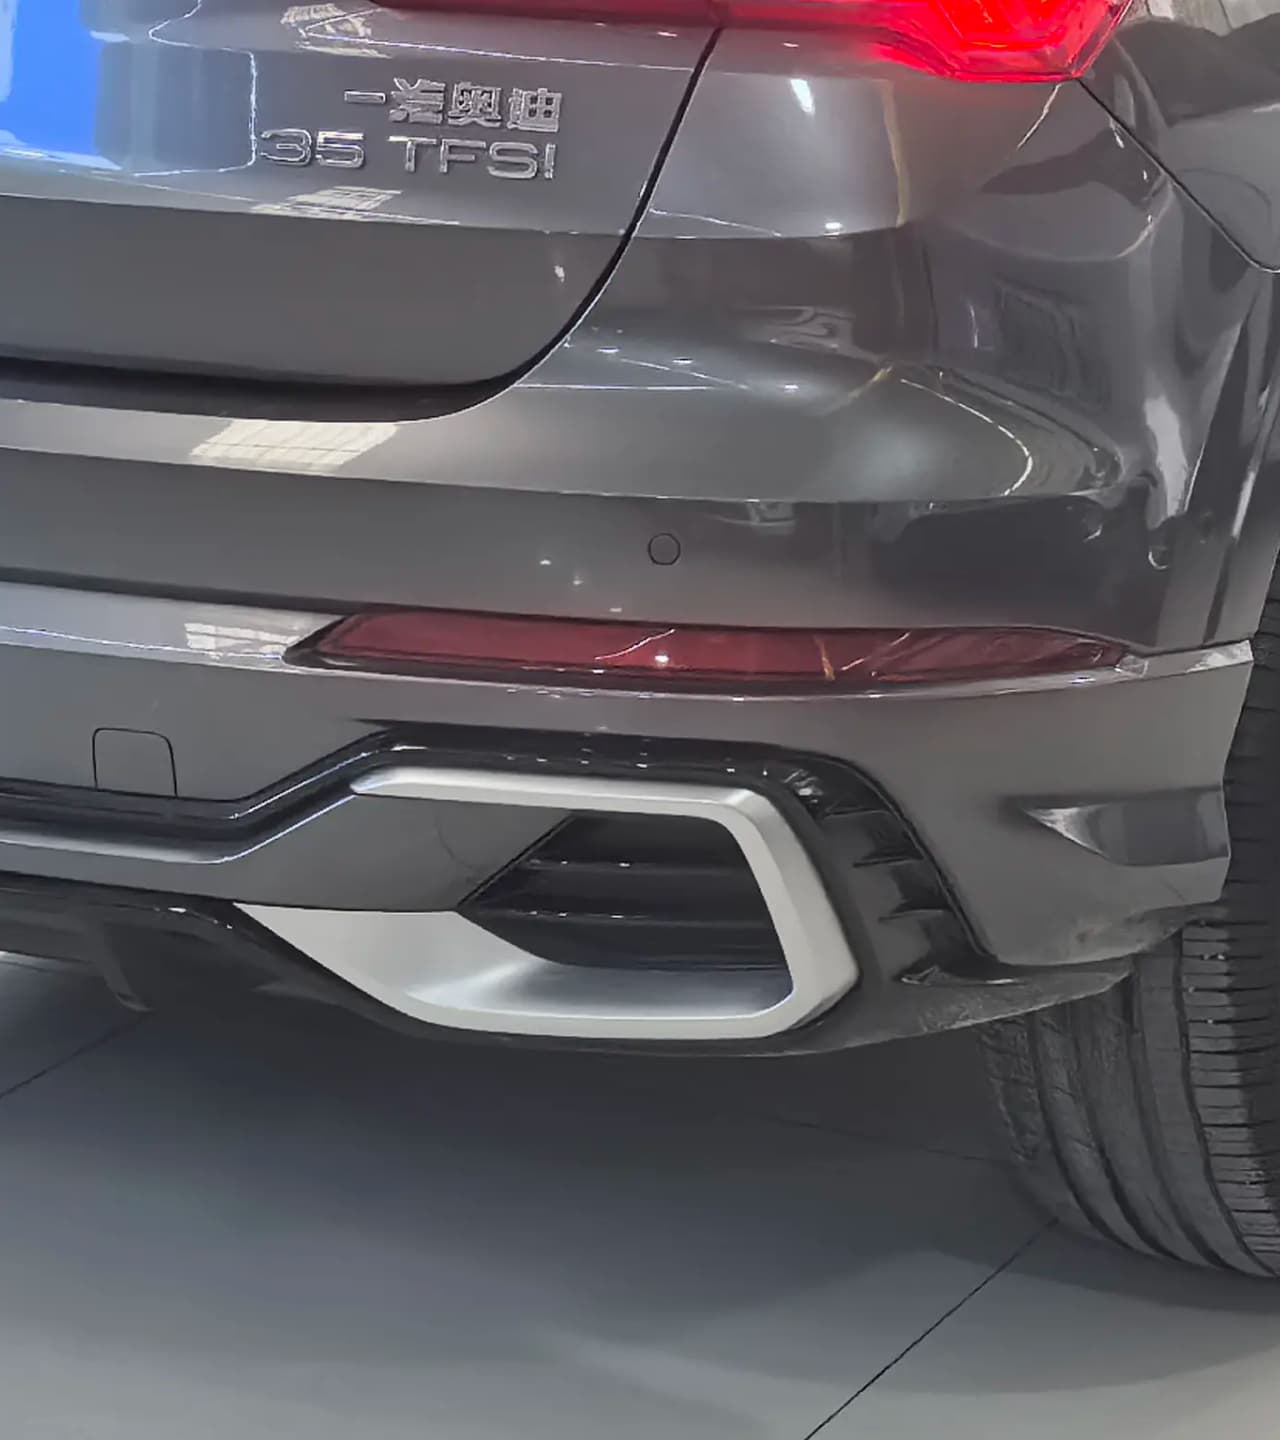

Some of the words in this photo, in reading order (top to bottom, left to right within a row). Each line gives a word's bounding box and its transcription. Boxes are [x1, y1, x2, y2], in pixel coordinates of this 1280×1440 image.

[344, 77, 563, 132] 一汽奥迪
[260, 127, 366, 169] 35
[387, 135, 557, 180] TFSI
